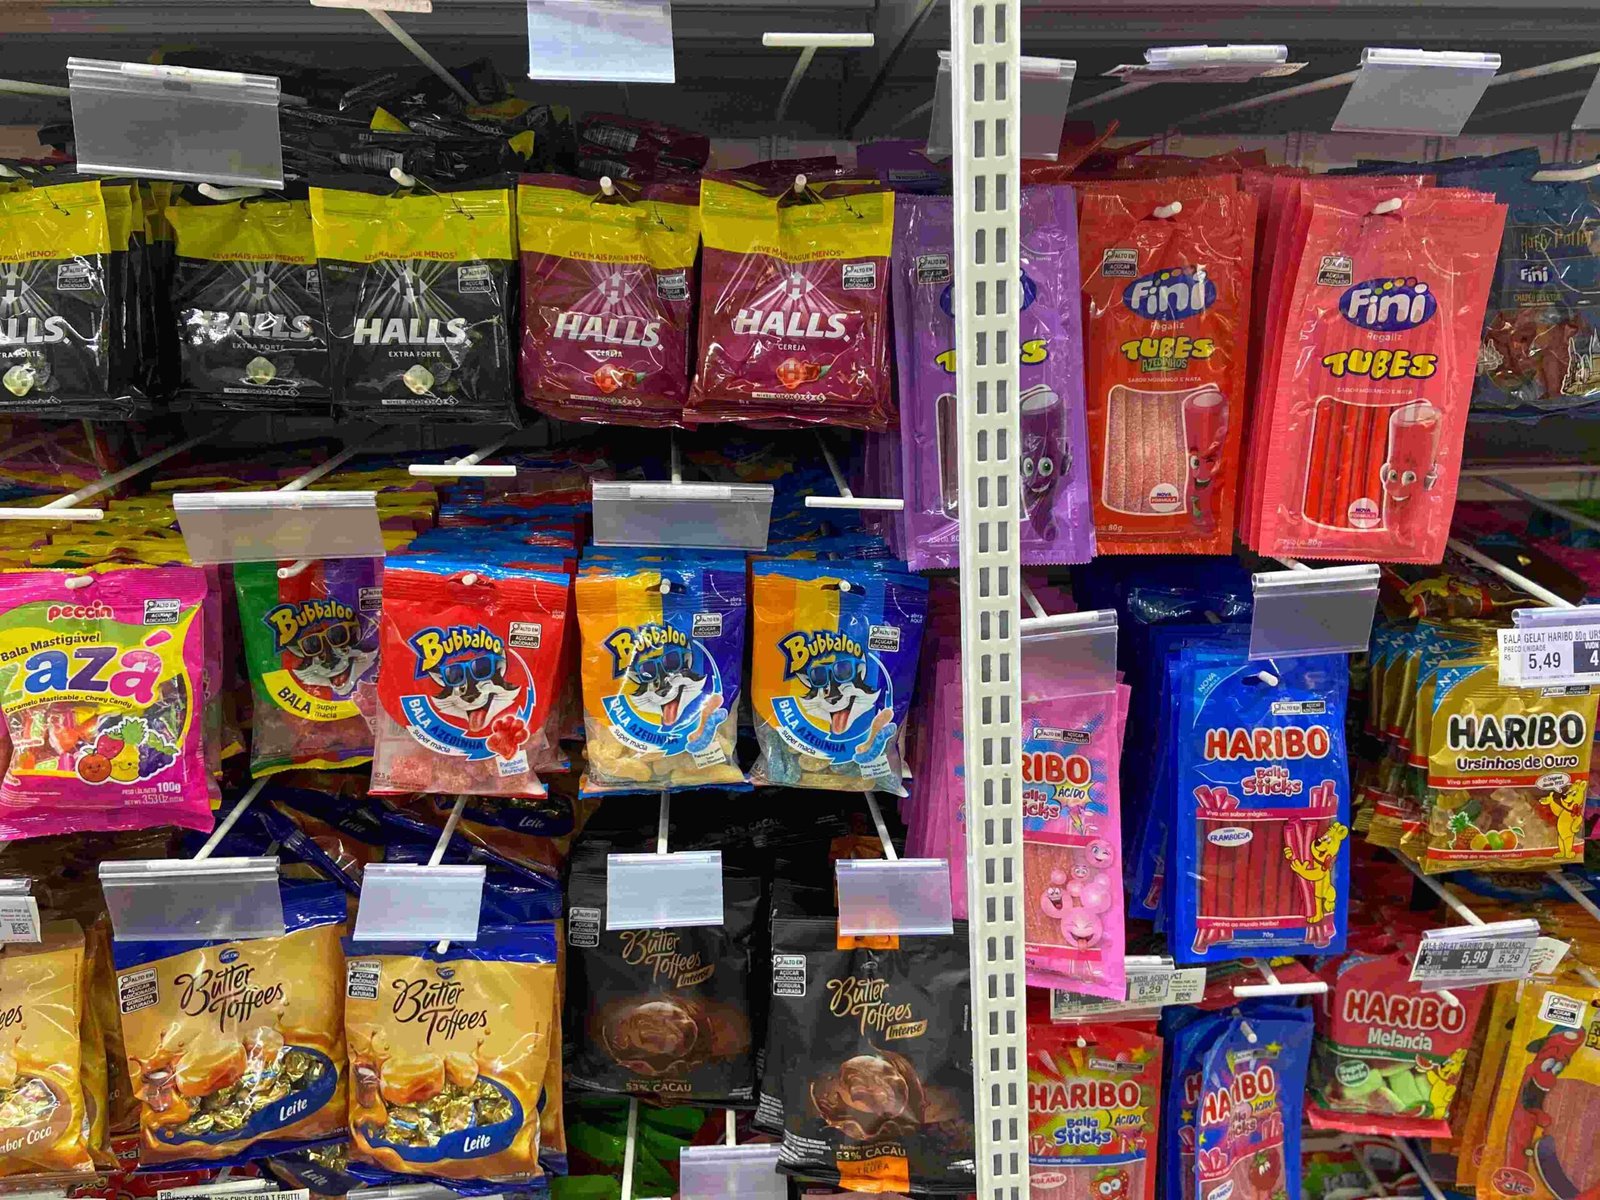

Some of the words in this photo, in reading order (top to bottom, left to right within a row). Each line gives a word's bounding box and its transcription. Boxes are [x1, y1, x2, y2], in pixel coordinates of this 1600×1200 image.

[1114, 251, 1127, 259] ALTO
[353, 318, 469, 345] HALLS
[553, 313, 660, 348] HALLS
[732, 308, 848, 338] HALLS
[1367, 332, 1402, 343] Regaliz
[778, 344, 806, 352] CEREJA
[1120, 336, 1216, 361] TUBES
[1322, 349, 1438, 380] TUBES
[48, 601, 113, 621] peccin
[270, 600, 353, 647] Bubbaloo
[1524, 633, 1546, 643] GELAT
[1547, 631, 1574, 641] HARIBO
[1575, 630, 1587, 641] 80g
[0, 646, 29, 661] Bala
[30, 633, 101, 651] Mastigável
[416, 629, 500, 671] Bubbaloo
[610, 626, 686, 671] Bubbaloo
[784, 633, 862, 673] Bubbaloo
[1529, 651, 1561, 671] 5,49
[1198, 672, 1217, 692] NOVA
[5, 700, 38, 714] Caramelo
[39, 694, 79, 703] Masticable
[85, 695, 108, 704] Chewy
[109, 697, 133, 709] Candy
[278, 686, 311, 714] BALA
[316, 705, 337, 713] super
[315, 711, 337, 719] macia
[610, 698, 631, 728] BALA
[408, 698, 431, 729] BALA
[430, 722, 484, 750] AZEDINHA
[778, 700, 797, 729] BALA
[797, 726, 847, 753] AZEDINHA
[1449, 713, 1585, 749] HARIBO
[412, 728, 431, 746] super
[430, 741, 452, 753] macia
[613, 728, 630, 745] super
[629, 739, 648, 751] macia
[781, 728, 799, 746] super
[797, 741, 817, 756] macia
[1206, 727, 1329, 760] HARIBO
[1456, 756, 1521, 770] Ursinhos
[1523, 756, 1540, 768] de
[1543, 754, 1578, 768] Ouro
[1256, 767, 1288, 779] Balla
[157, 782, 181, 793] 100g
[1058, 785, 1086, 799] ÁCIDO
[1243, 777, 1302, 796] Sticks
[519, 815, 545, 829] Leite
[1210, 832, 1250, 842] FRAMBOESA
[619, 930, 680, 965] Butter
[1461, 951, 1487, 964] 5,98
[645, 952, 701, 984] Toffees
[1424, 956, 1432, 966] 3
[1498, 954, 1521, 964] 6,29
[1170, 972, 1183, 980] PCT
[174, 964, 255, 1016] Butter
[826, 976, 889, 1018] Butter
[1063, 994, 1070, 1002] 3
[1139, 985, 1161, 996] 6,29
[209, 983, 283, 1033] Toffees
[392, 979, 465, 1023] Butter
[852, 1001, 912, 1036] Toffees
[1345, 990, 1466, 1033] HARIBO
[418, 1004, 488, 1046] Toffees
[889, 1024, 922, 1038] Intense
[1368, 1027, 1433, 1051] Melancia
[1338, 1062, 1365, 1074] Super
[1340, 1071, 1368, 1083] Macio
[626, 1082, 649, 1092] 53%
[653, 1082, 693, 1092] CACAU
[1028, 1081, 1140, 1113] HARIBO
[279, 1098, 308, 1121] Leite
[1254, 1102, 1273, 1112] ÁCIDO
[1066, 1116, 1099, 1129] Balla
[1115, 1113, 1141, 1126] ÁCIDO
[26, 1126, 52, 1144] Coco
[463, 1134, 491, 1153] Leite
[1053, 1127, 1112, 1145] Sticks
[836, 1151, 862, 1160] 53%
[865, 1148, 906, 1158] CACAU
[857, 1163, 890, 1174] TRUFA
